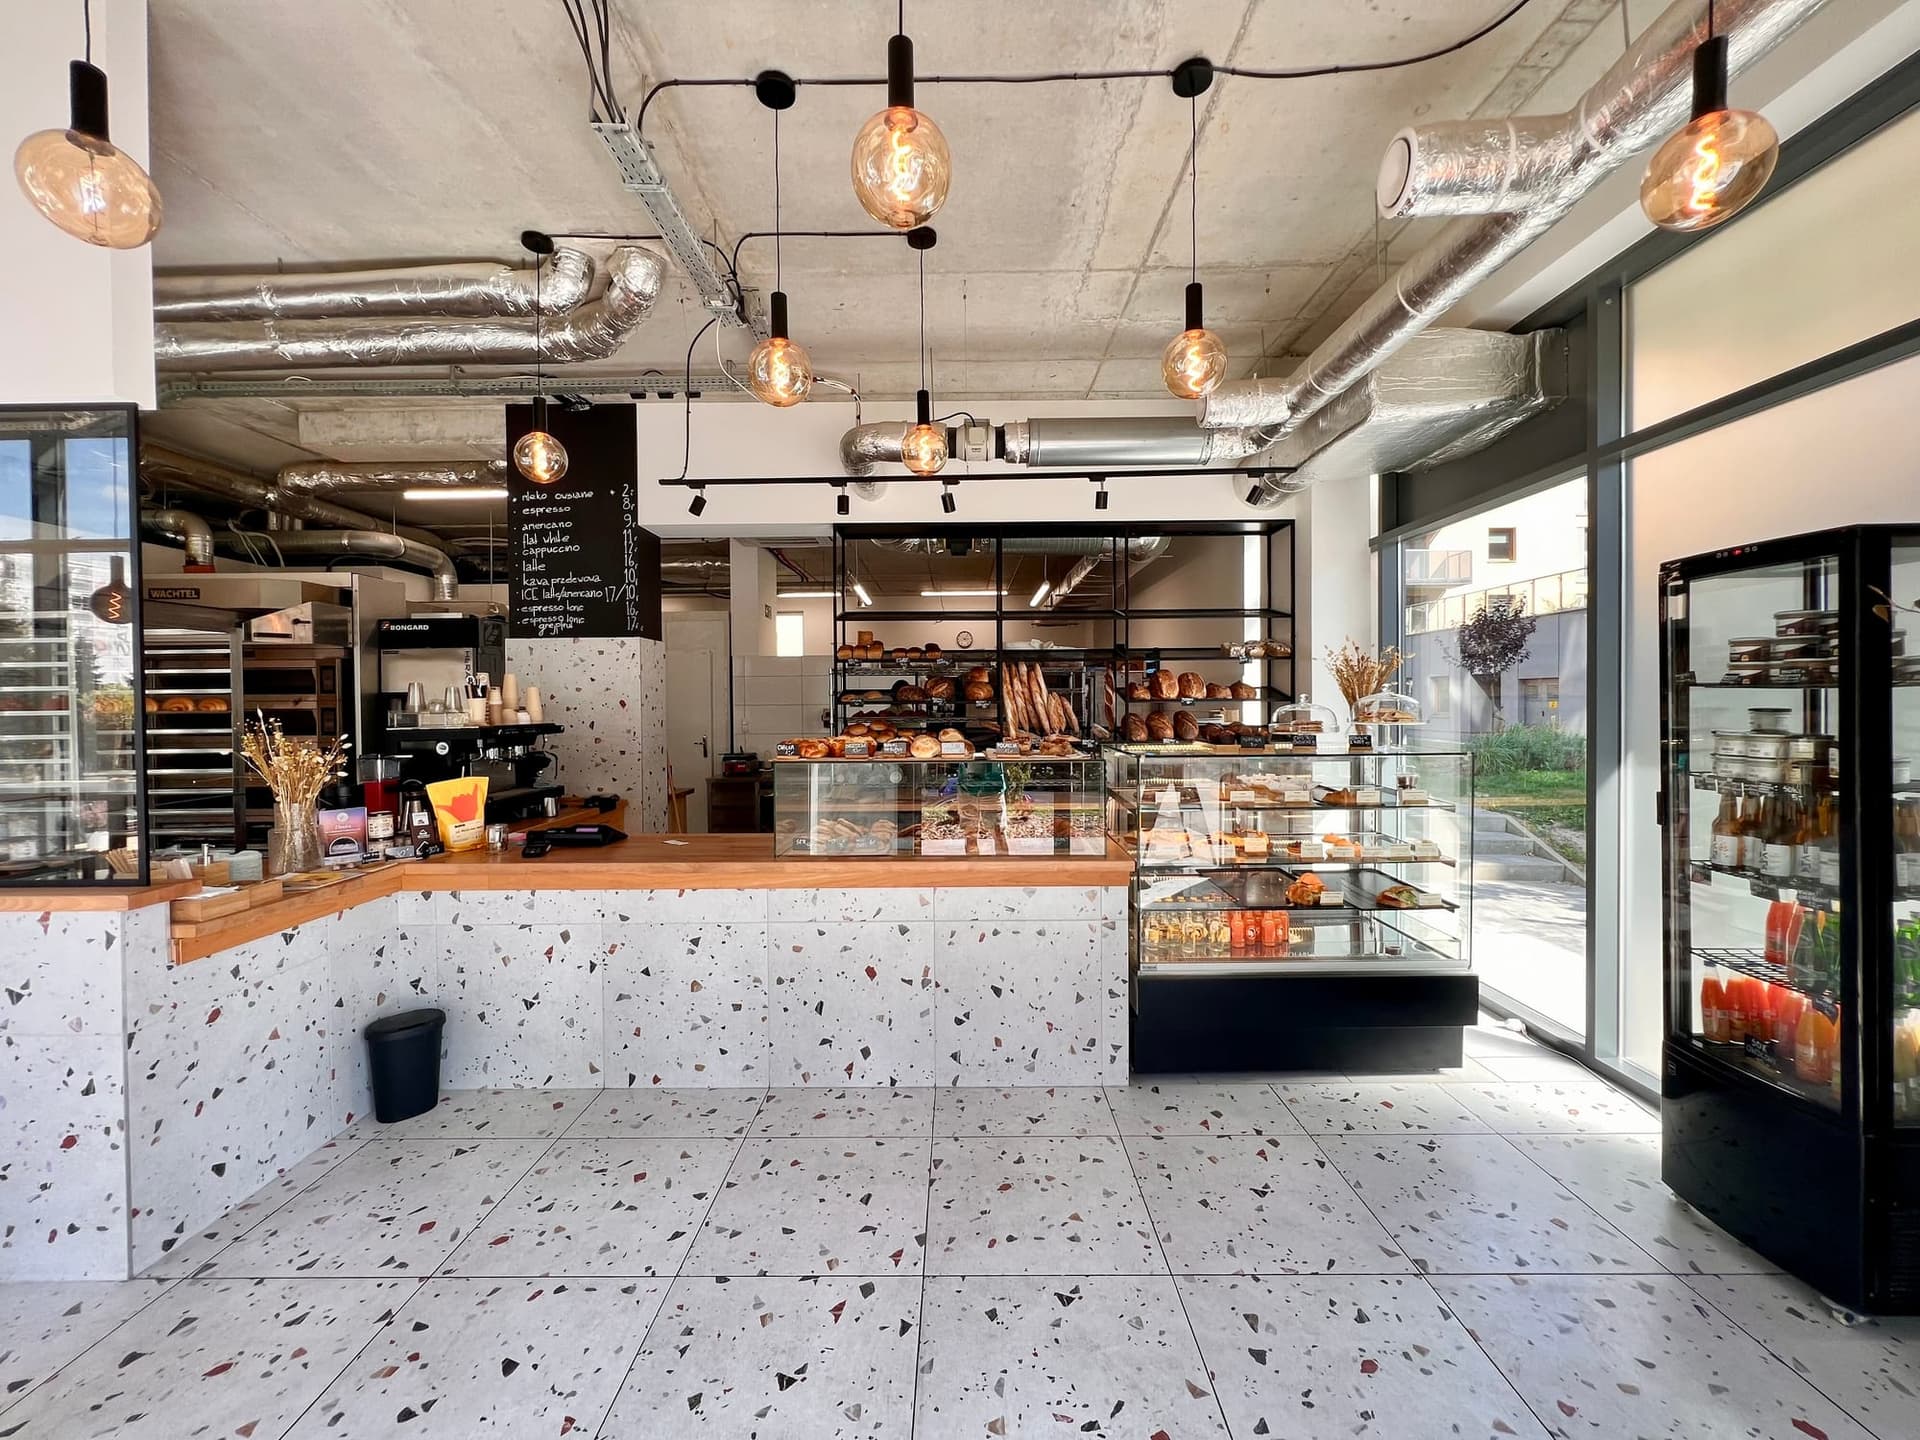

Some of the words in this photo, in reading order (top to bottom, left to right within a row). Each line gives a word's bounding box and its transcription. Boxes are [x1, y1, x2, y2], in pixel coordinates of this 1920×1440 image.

[521, 506, 571, 517] espresso
[521, 521, 573, 531] americano
[521, 544, 581, 559] cappuccino
[150, 589, 198, 598] WACHTEL
[521, 587, 539, 600] ICE
[521, 604, 565, 617] espresso
[521, 615, 565, 627] espresso
